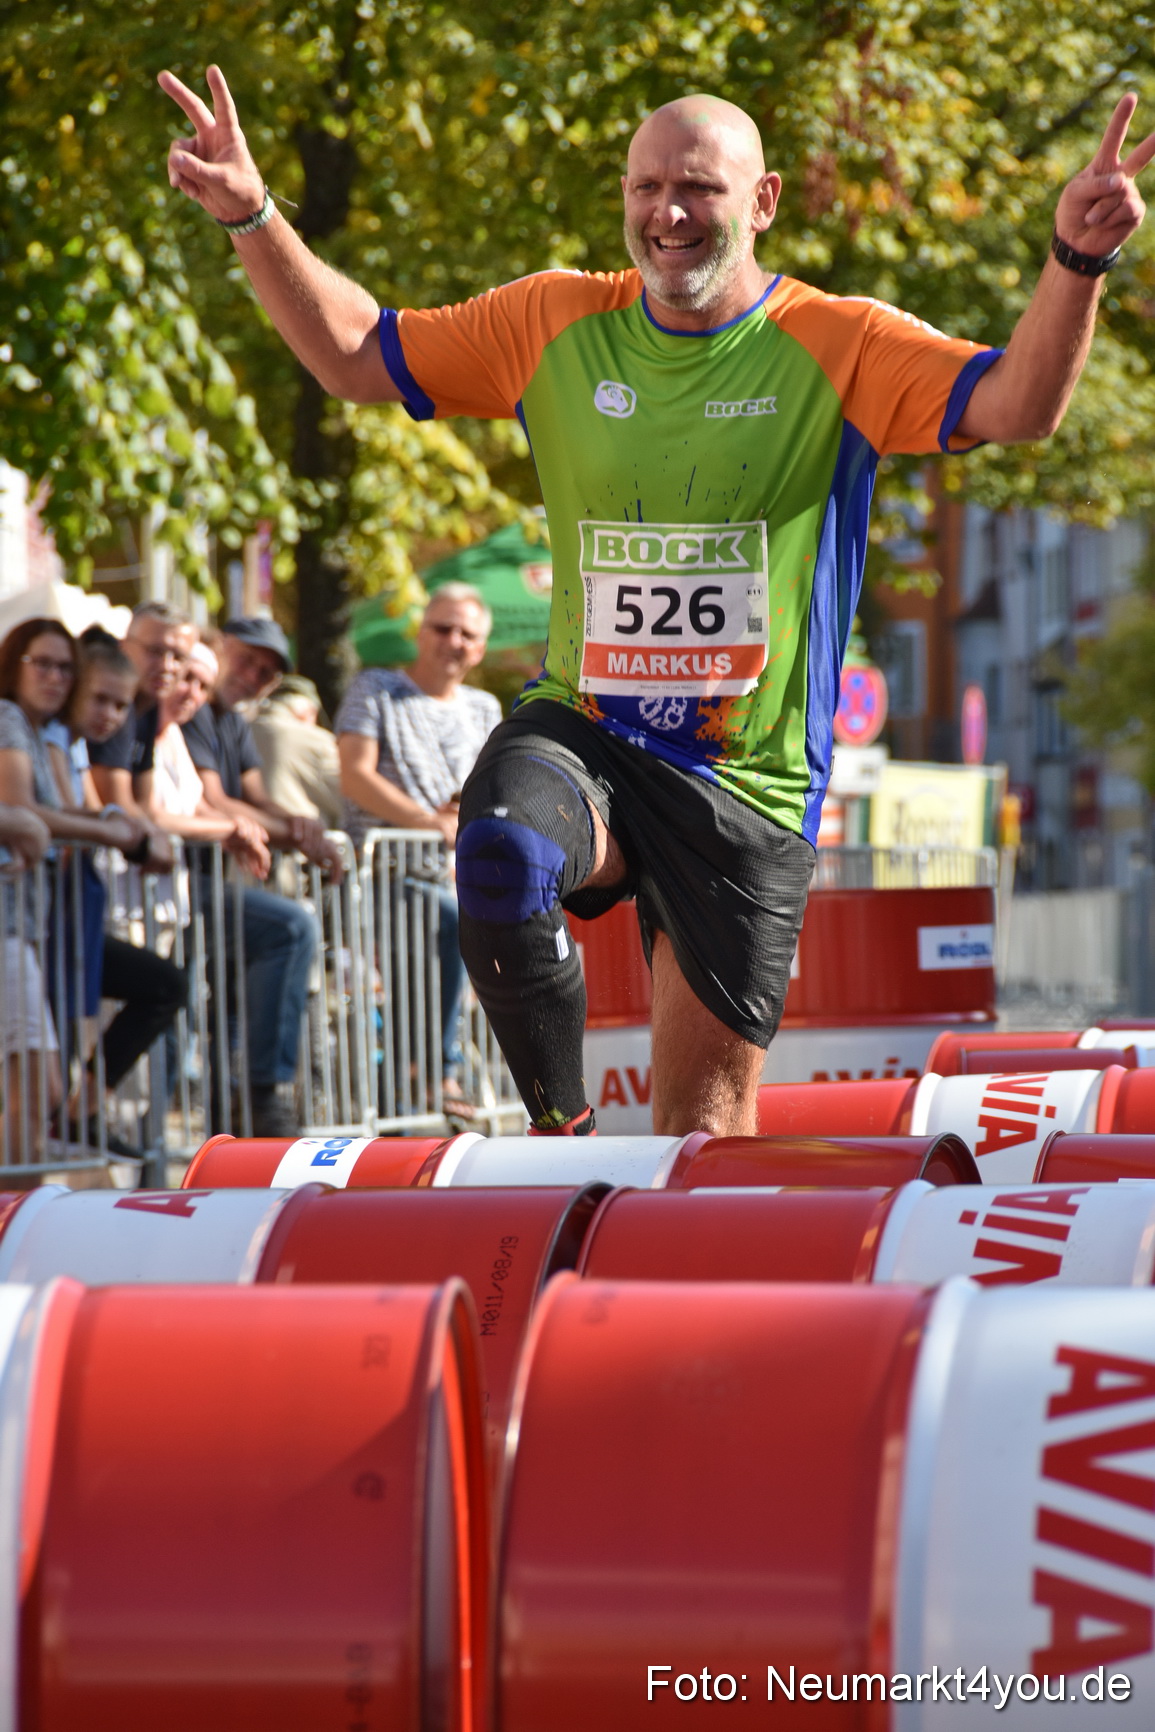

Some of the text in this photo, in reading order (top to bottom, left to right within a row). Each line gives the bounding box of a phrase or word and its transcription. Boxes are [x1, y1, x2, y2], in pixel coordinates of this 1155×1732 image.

[705, 396, 778, 418] BOCK
[594, 530, 749, 569] BOCK
[614, 584, 726, 636] 526
[607, 652, 733, 676] MARKUS
[480, 1236, 519, 1336] M011/08/19
